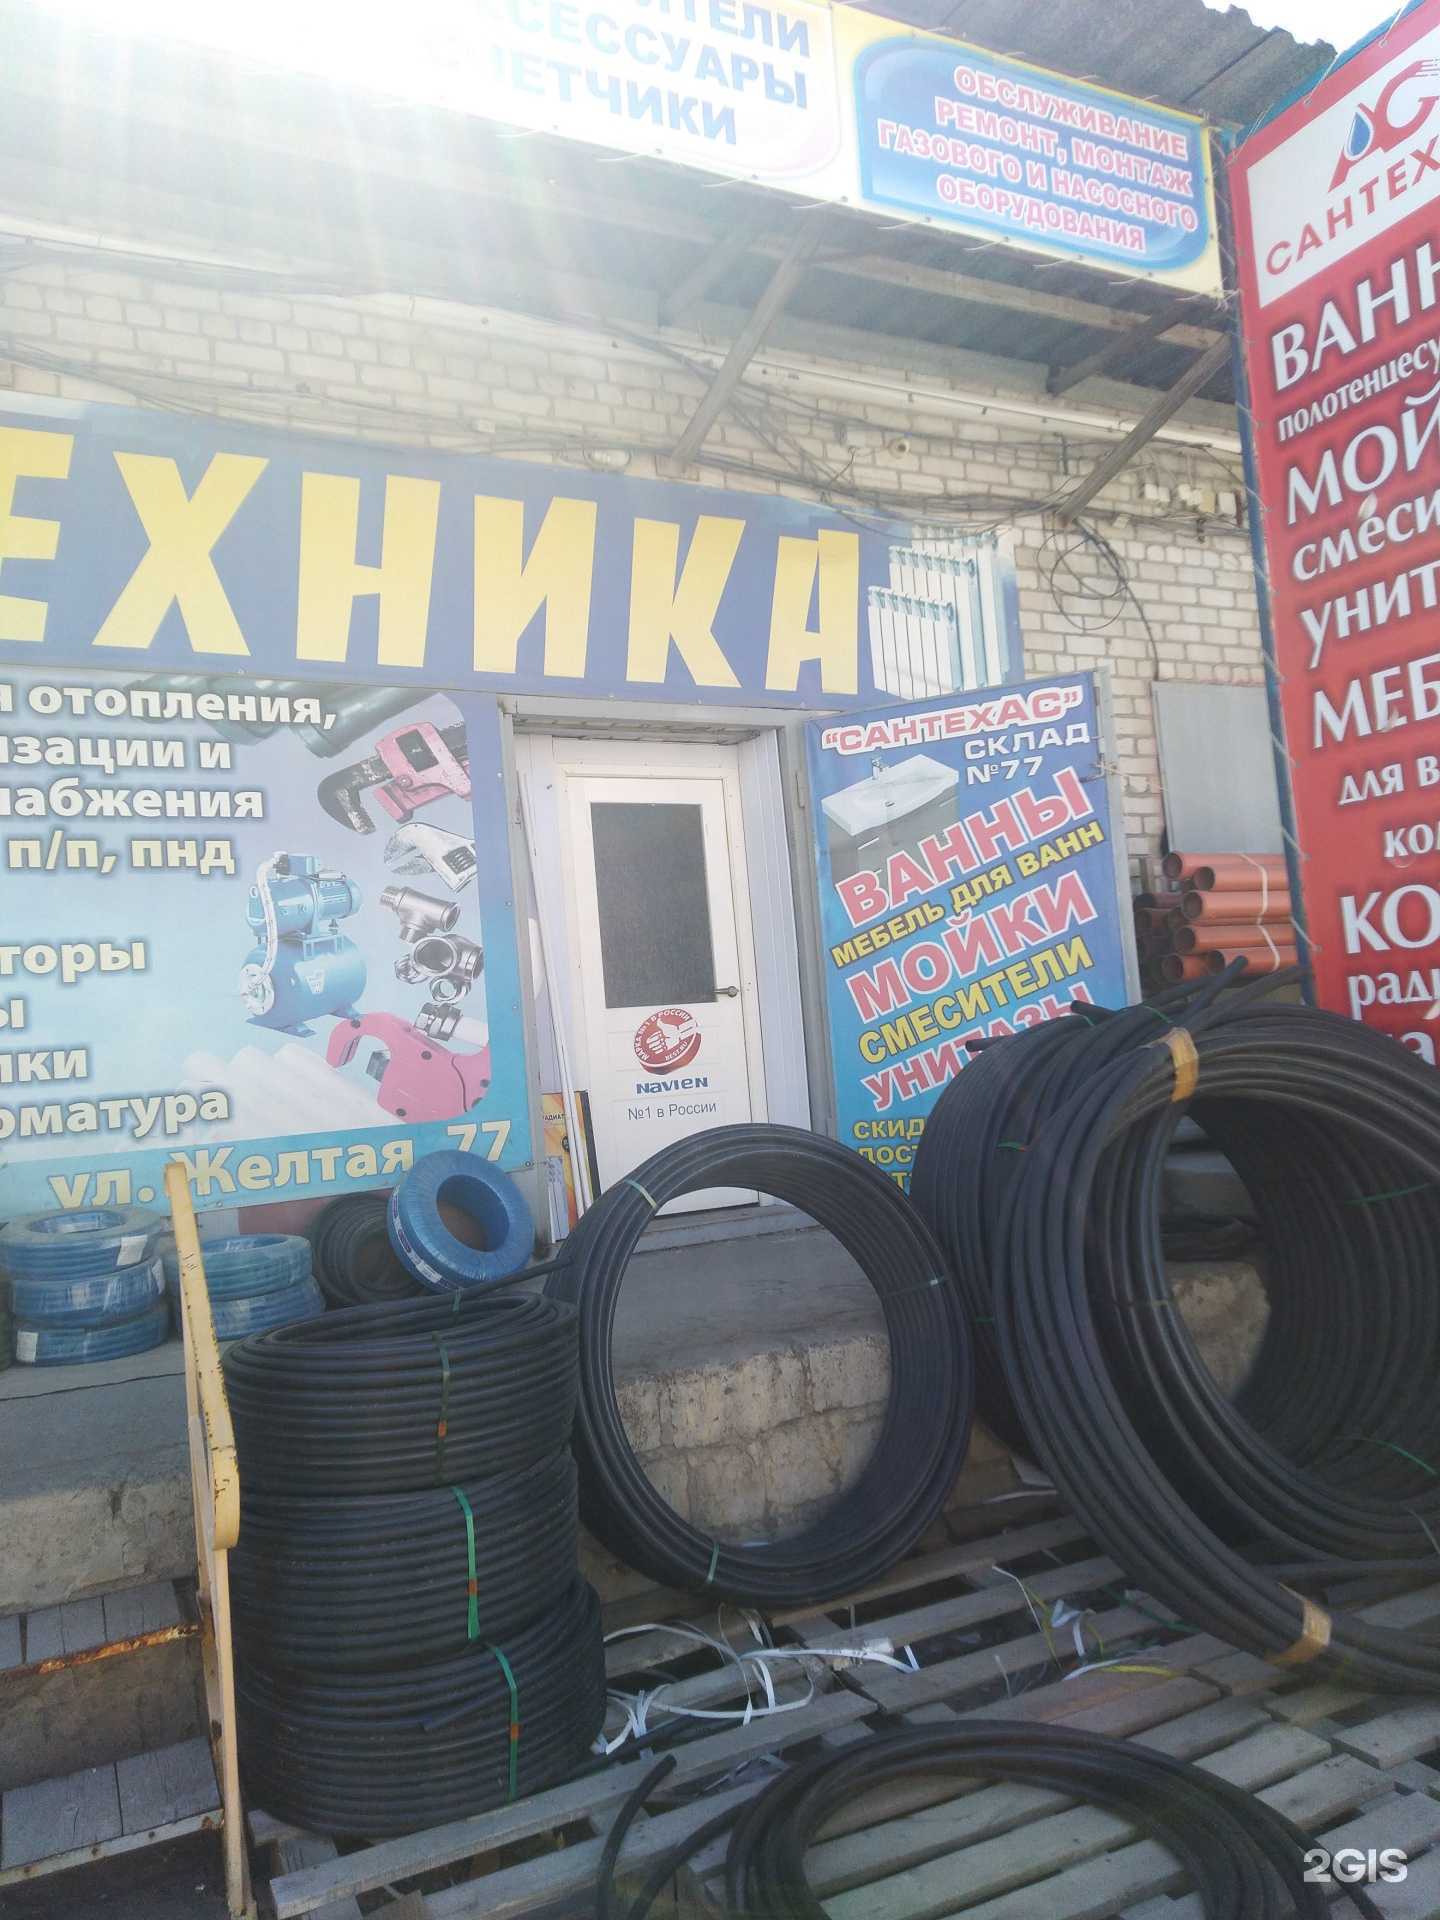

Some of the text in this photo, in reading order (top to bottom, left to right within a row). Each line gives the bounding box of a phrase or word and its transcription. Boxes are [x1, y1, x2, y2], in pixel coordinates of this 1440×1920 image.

[934, 97, 1193, 197] РЕМОНТ, МОНТАЖ
[954, 66, 1188, 161] ОБСЛУЖИВАНИЕ
[877, 118, 1198, 232] ГАЗОВОГО И НАСОСНОГО
[937, 175, 1146, 251] ОБОРУДОВАНИЯ
[28, 685, 337, 729] отопления,
[964, 722, 1091, 760] СКЛАД
[0, 734, 231, 774] зации и
[967, 755, 1043, 785] №77
[8, 830, 235, 875] п/п, пнд
[837, 766, 1095, 928] ВАННЫ
[1383, 820, 1440, 858] ко
[831, 820, 1105, 970] МЕБЕЛЬ ДЛЯ ВАНН
[1340, 884, 1440, 954] КО
[846, 869, 1099, 1024] МОЙКИ
[859, 935, 1095, 1067] СМЕСИТЕЛИ
[627, 1105, 651, 1121] №1
[669, 1102, 717, 1118] России
[170, 1139, 415, 1197] Желтая
[447, 1119, 511, 1162] 77
[858, 1143, 919, 1167] ДОС
